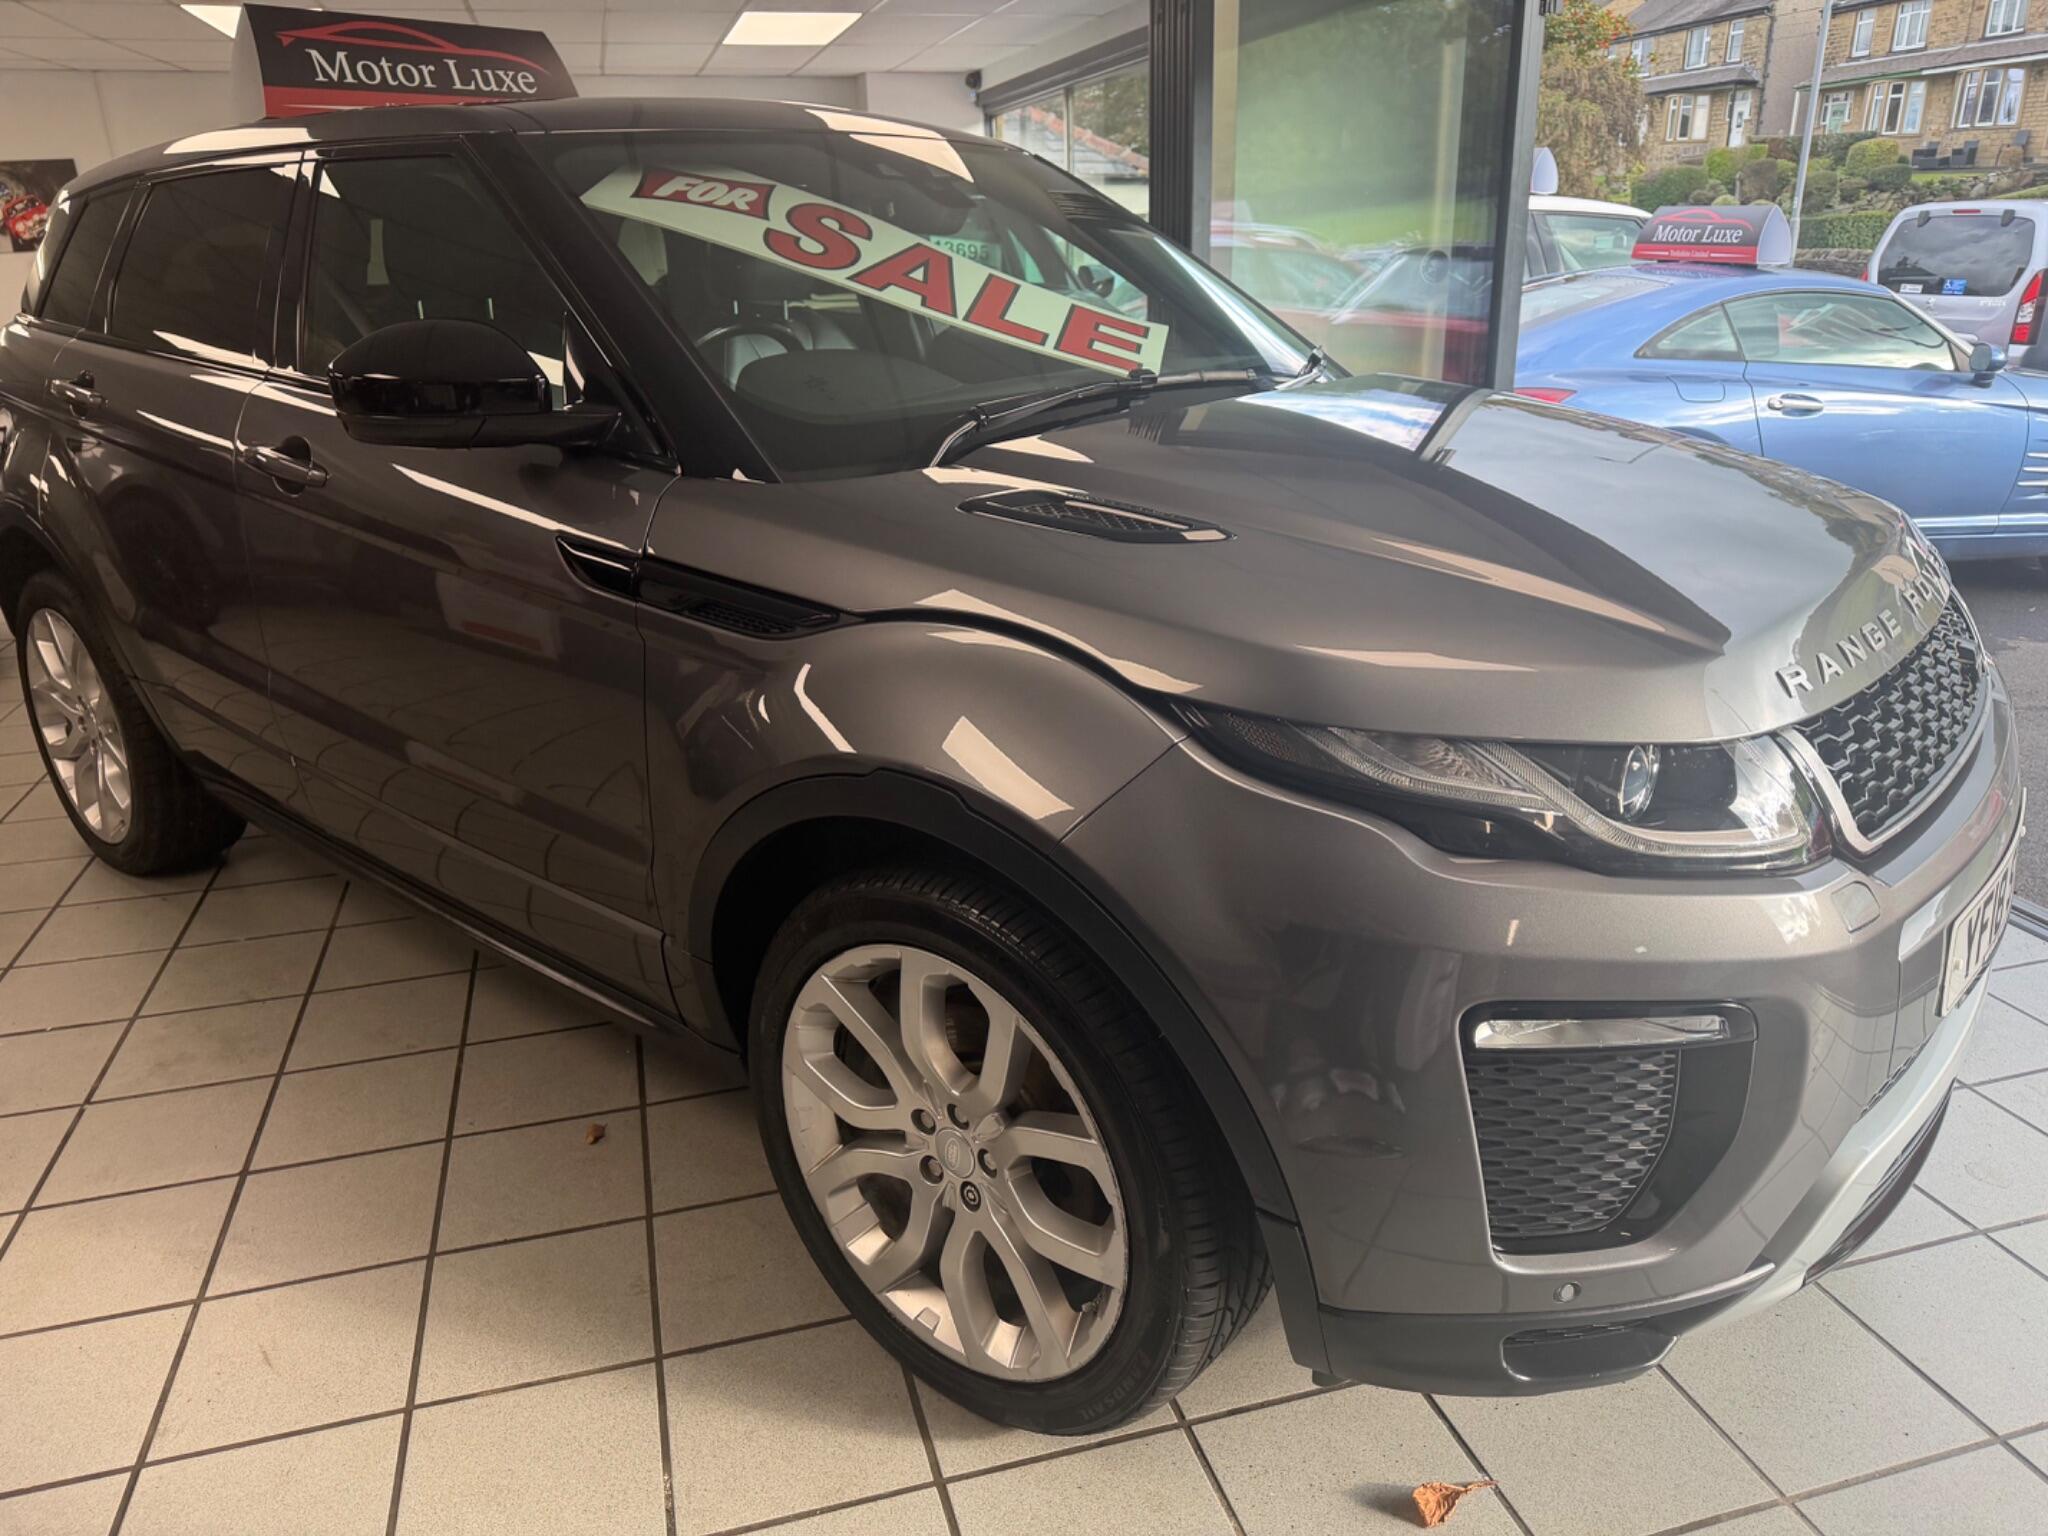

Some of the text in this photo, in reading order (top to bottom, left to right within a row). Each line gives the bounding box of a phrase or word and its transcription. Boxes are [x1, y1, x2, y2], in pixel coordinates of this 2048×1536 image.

[306, 48, 539, 95] Motor Luxe
[1652, 225, 1744, 244] Motor Luxe
[652, 174, 1151, 375] FOR SALE
[1777, 609, 1902, 699] RANGE
